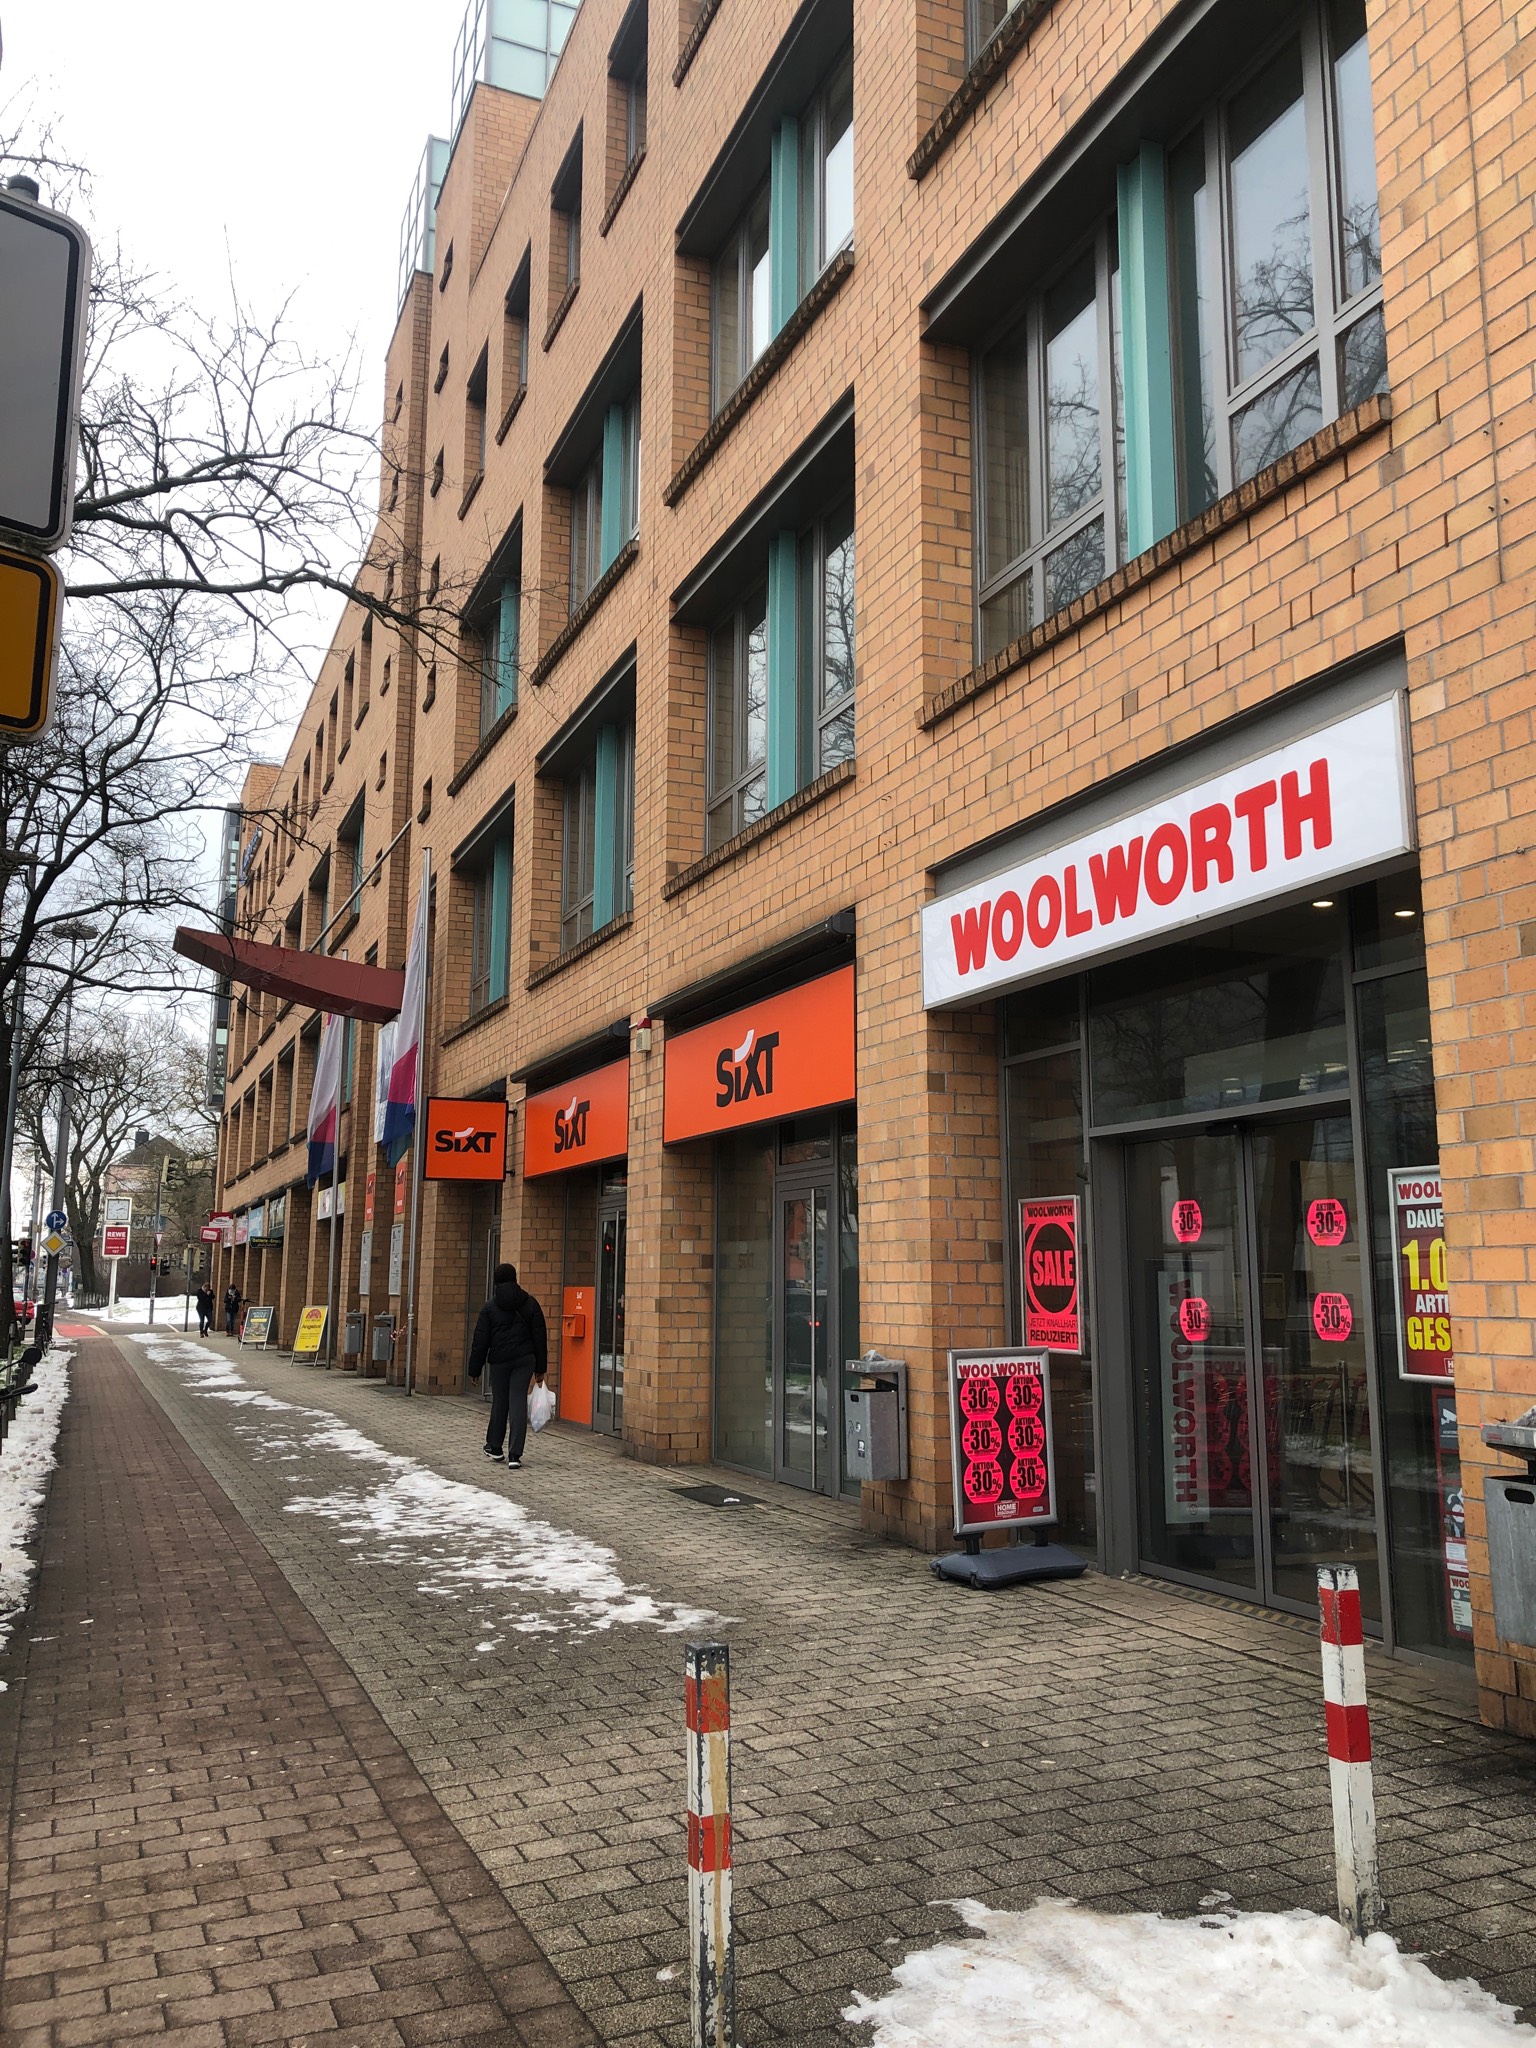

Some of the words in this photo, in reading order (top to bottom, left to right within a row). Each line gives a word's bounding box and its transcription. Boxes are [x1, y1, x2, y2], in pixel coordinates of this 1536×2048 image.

[951, 757, 1332, 976] WOOLWORTH
[1027, 1205, 1073, 1218] WOOLWORTH
[1179, 1203, 1194, 1211] AKTION
[1316, 1203, 1336, 1211] AKTION
[1032, 1250, 1074, 1287] SALE
[1321, 1296, 1342, 1304] AKTION
[1029, 1318, 1045, 1326] JETZT
[1407, 1316, 1451, 1352] GES
[959, 1361, 1041, 1378] WOOLWORTH
[969, 1379, 989, 1388] AKTION
[1013, 1376, 1033, 1385] AKTION
[971, 1420, 992, 1429] AKTION
[1015, 1417, 1035, 1426] AKTION
[973, 1462, 994, 1471] AKTION
[1018, 1458, 1037, 1467] AKTION
